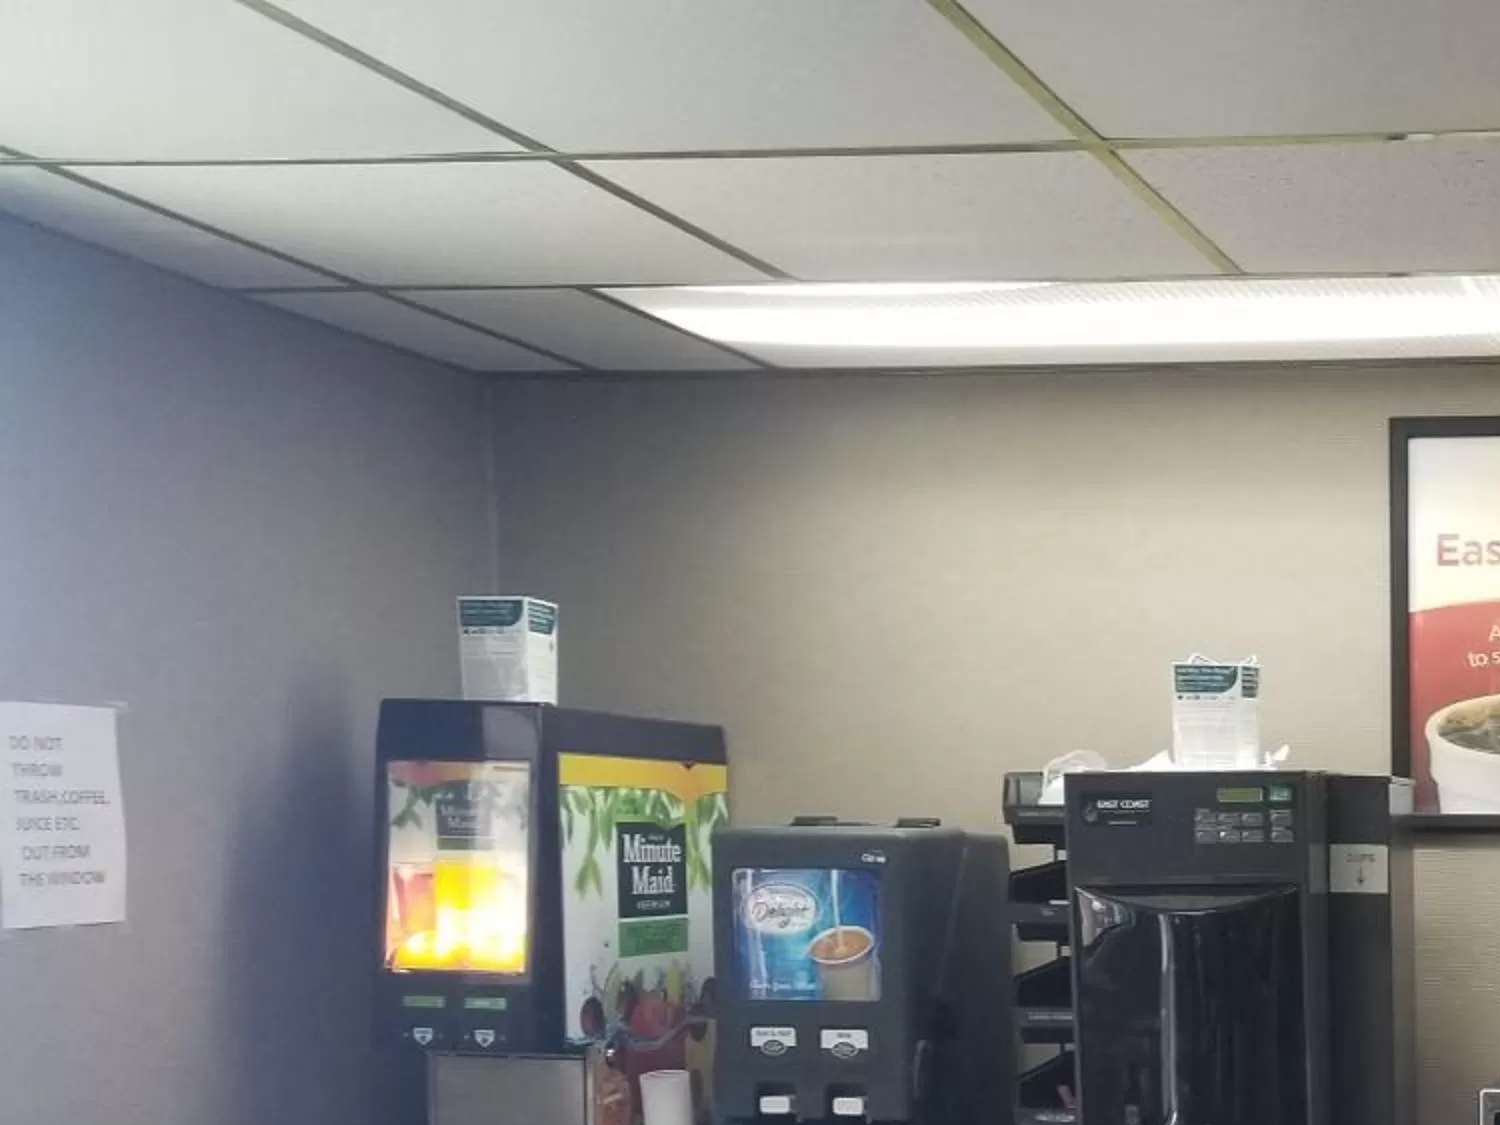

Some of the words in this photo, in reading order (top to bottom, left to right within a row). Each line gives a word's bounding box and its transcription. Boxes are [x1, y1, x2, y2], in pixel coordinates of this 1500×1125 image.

[1467, 650, 1488, 668] to
[622, 832, 682, 863] Minute
[631, 865, 677, 895] Maid
